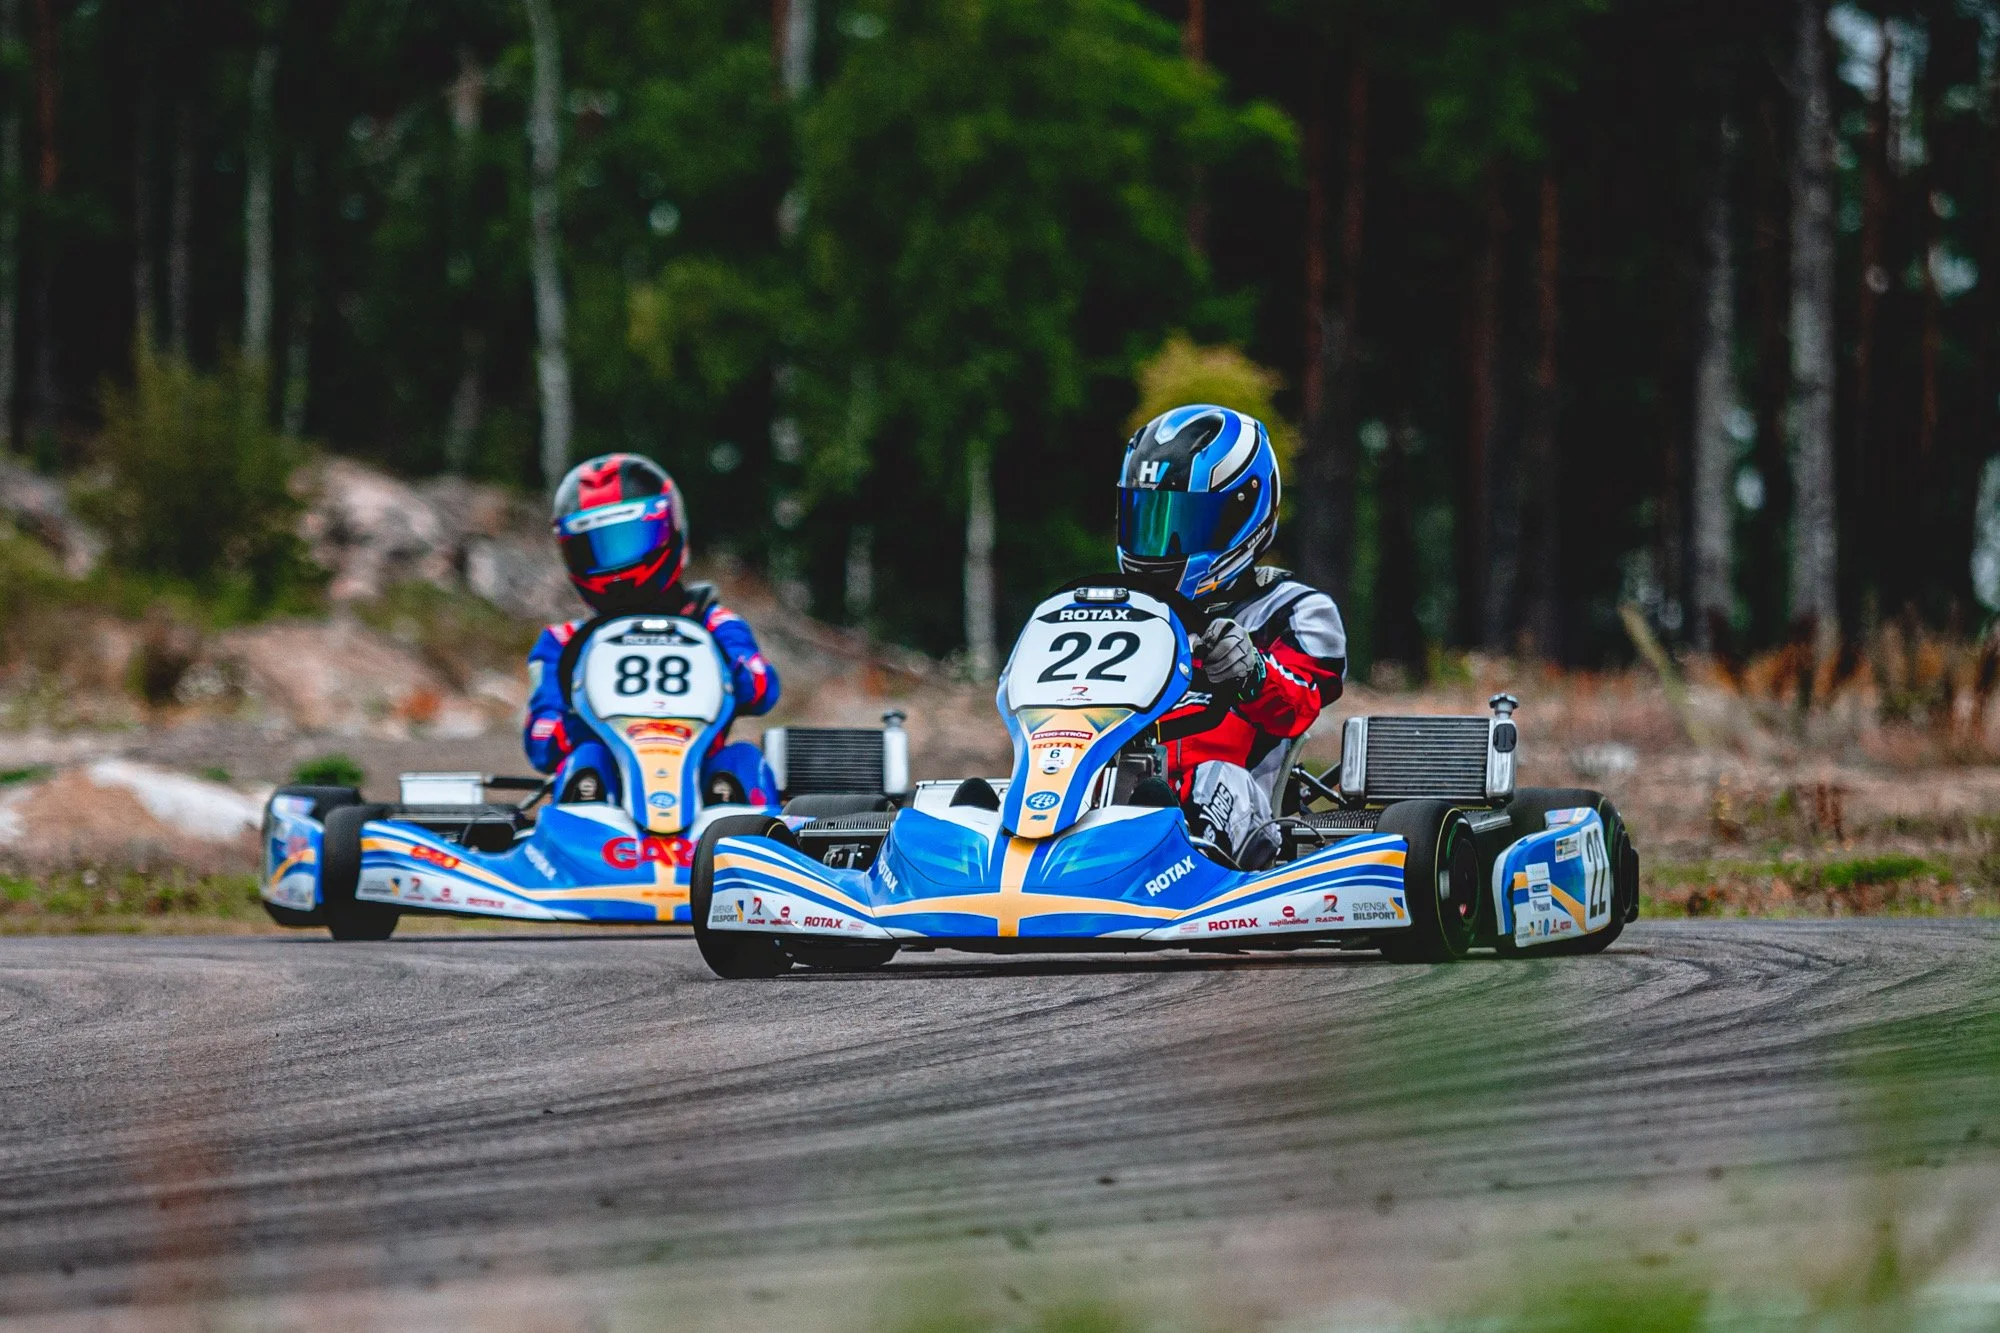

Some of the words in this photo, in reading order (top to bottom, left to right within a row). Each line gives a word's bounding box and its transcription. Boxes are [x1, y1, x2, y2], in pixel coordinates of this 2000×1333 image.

[1059, 609, 1130, 621] ROTAX
[1037, 631, 1141, 683] 22
[614, 655, 691, 697] 88
[1032, 742, 1084, 750] ROTAX
[1049, 749, 1061, 759] 6
[1144, 855, 1196, 897] ROTAX
[1352, 901, 1388, 911] SVENSK
[1353, 911, 1396, 921] BILSPORT
[803, 916, 843, 929] ROTAX
[1208, 917, 1259, 932] ROTAX
